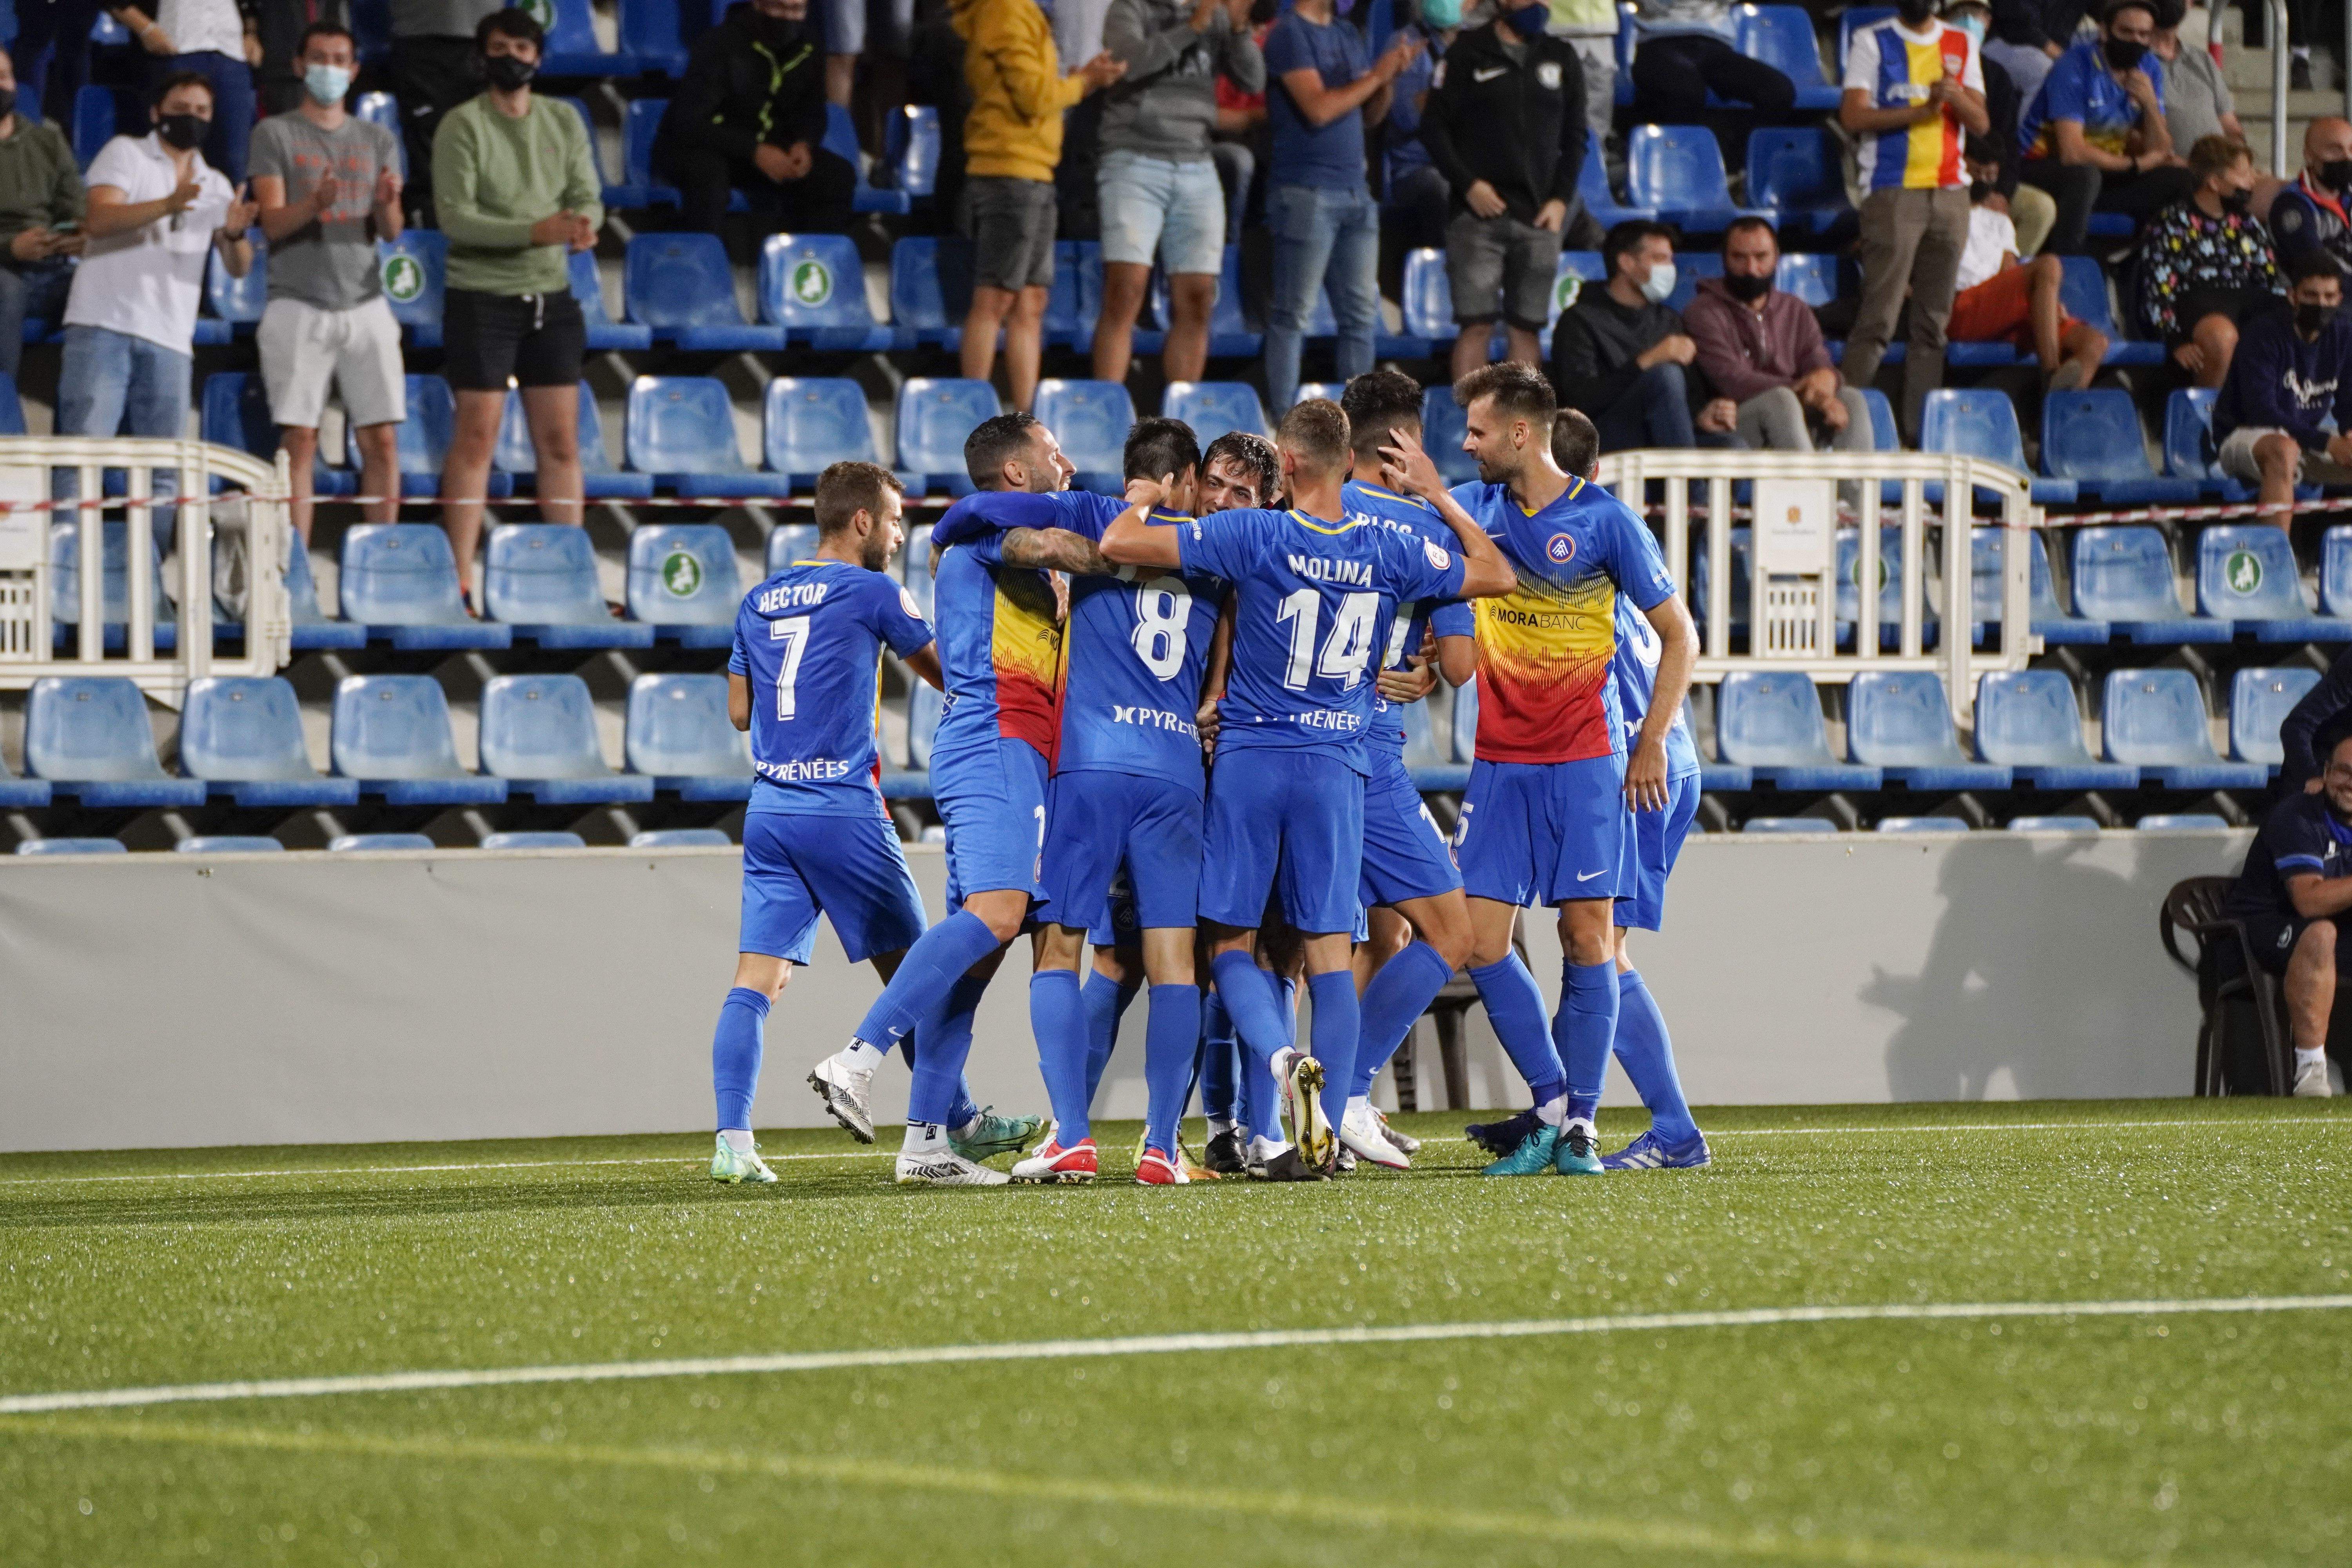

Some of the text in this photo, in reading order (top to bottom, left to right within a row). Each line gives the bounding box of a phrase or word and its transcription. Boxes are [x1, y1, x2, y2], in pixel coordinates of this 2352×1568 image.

[757, 583, 828, 613] HECTOR
[1288, 555, 1372, 588] MOLINA
[1131, 576, 1192, 682] 8
[1276, 588, 1379, 692] 14
[770, 615, 810, 721] 7
[756, 758, 849, 780] PYRÉNÉES
